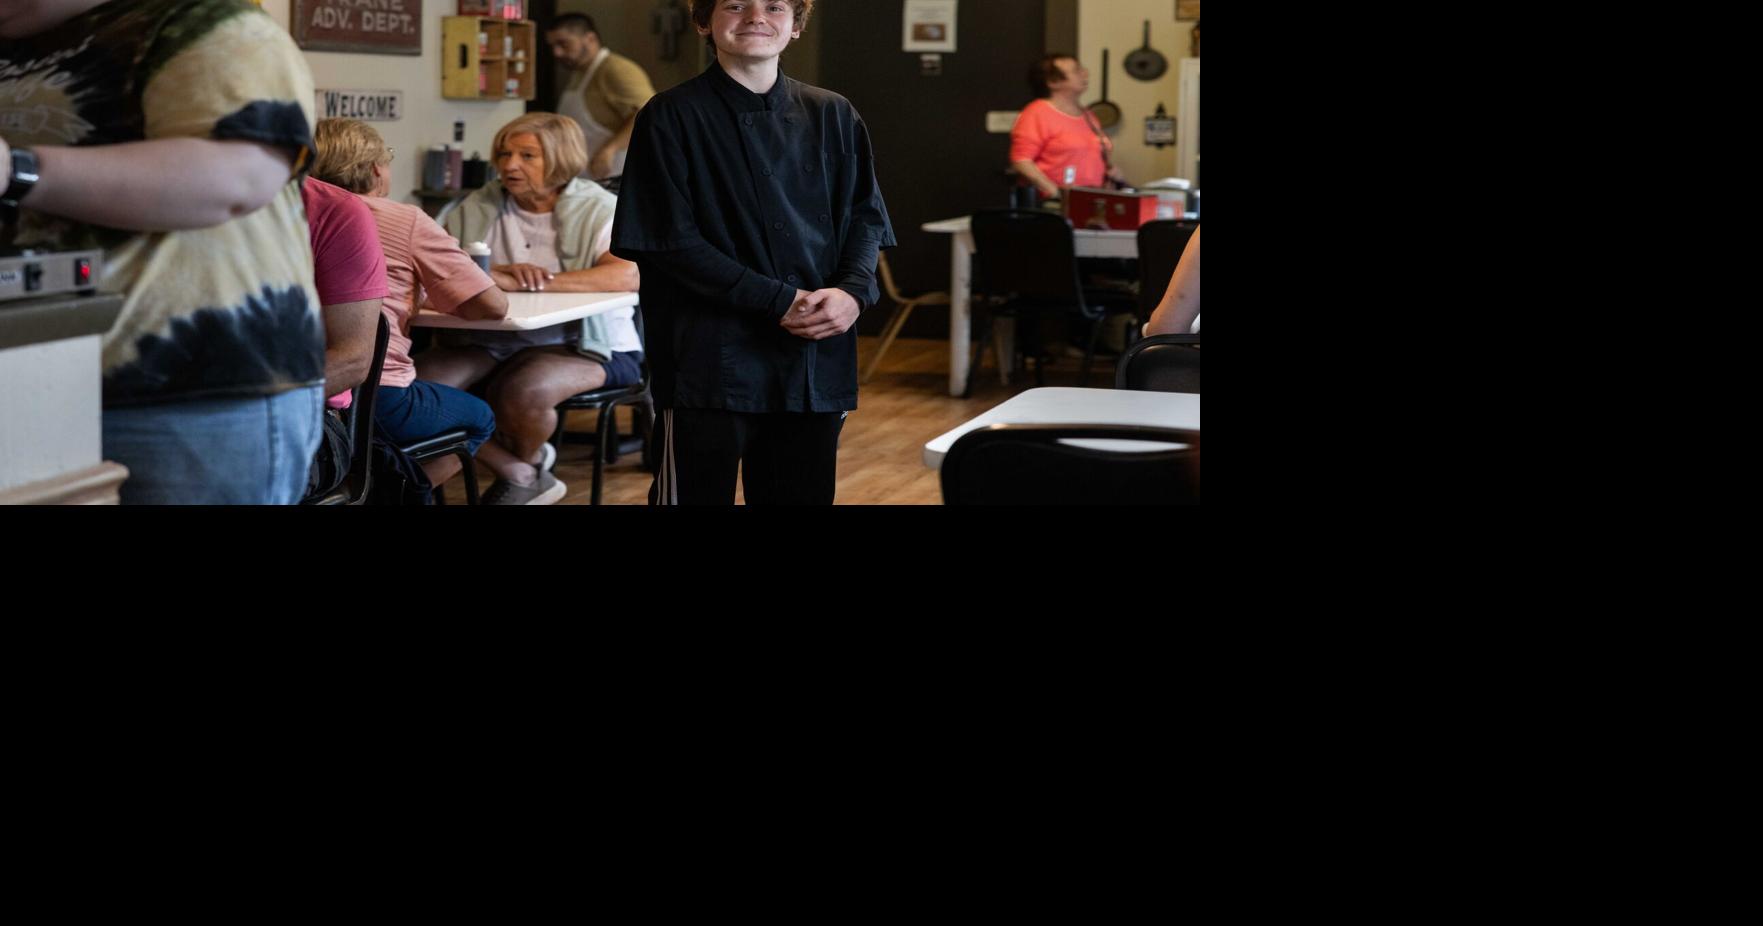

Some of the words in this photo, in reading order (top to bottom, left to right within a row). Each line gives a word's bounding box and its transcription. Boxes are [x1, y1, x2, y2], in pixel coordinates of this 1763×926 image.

[326, 0, 404, 11] ANE
[311, 6, 353, 29] ADV.
[361, 11, 415, 34] DEPT.
[325, 91, 397, 118] WELCOME
